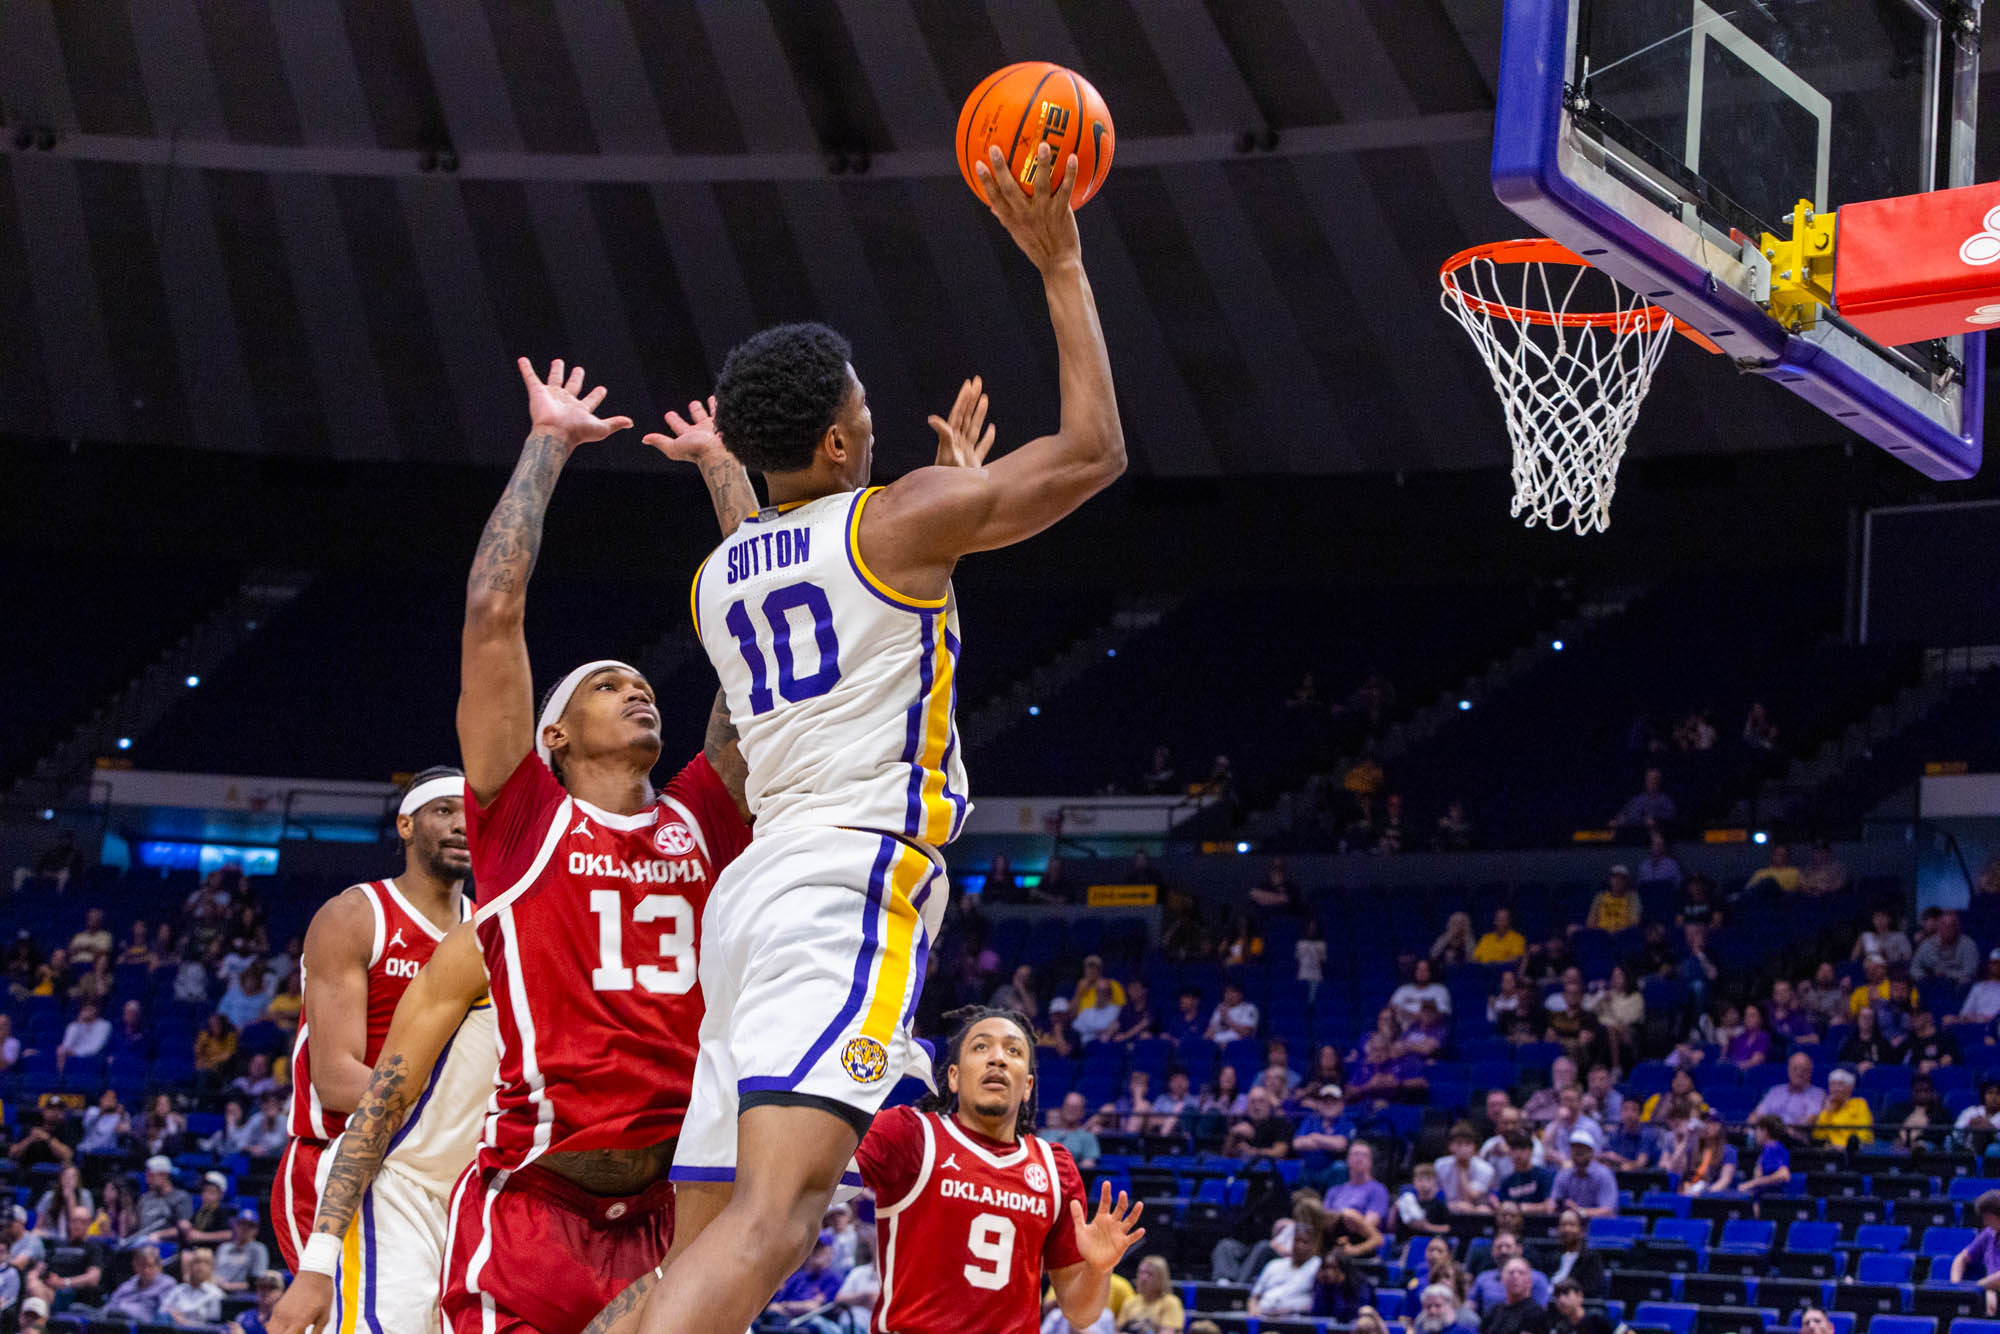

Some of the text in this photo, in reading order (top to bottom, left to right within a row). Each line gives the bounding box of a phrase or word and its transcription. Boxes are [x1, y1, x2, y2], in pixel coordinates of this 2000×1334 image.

[728, 528, 810, 584] SUTTON
[725, 581, 842, 716] 10
[569, 852, 706, 883] OKLAHOMA
[656, 826, 694, 854] SEC
[589, 889, 698, 995] 13
[941, 1179, 1047, 1217] OKLAHOMA
[964, 1213, 1016, 1290] 9
